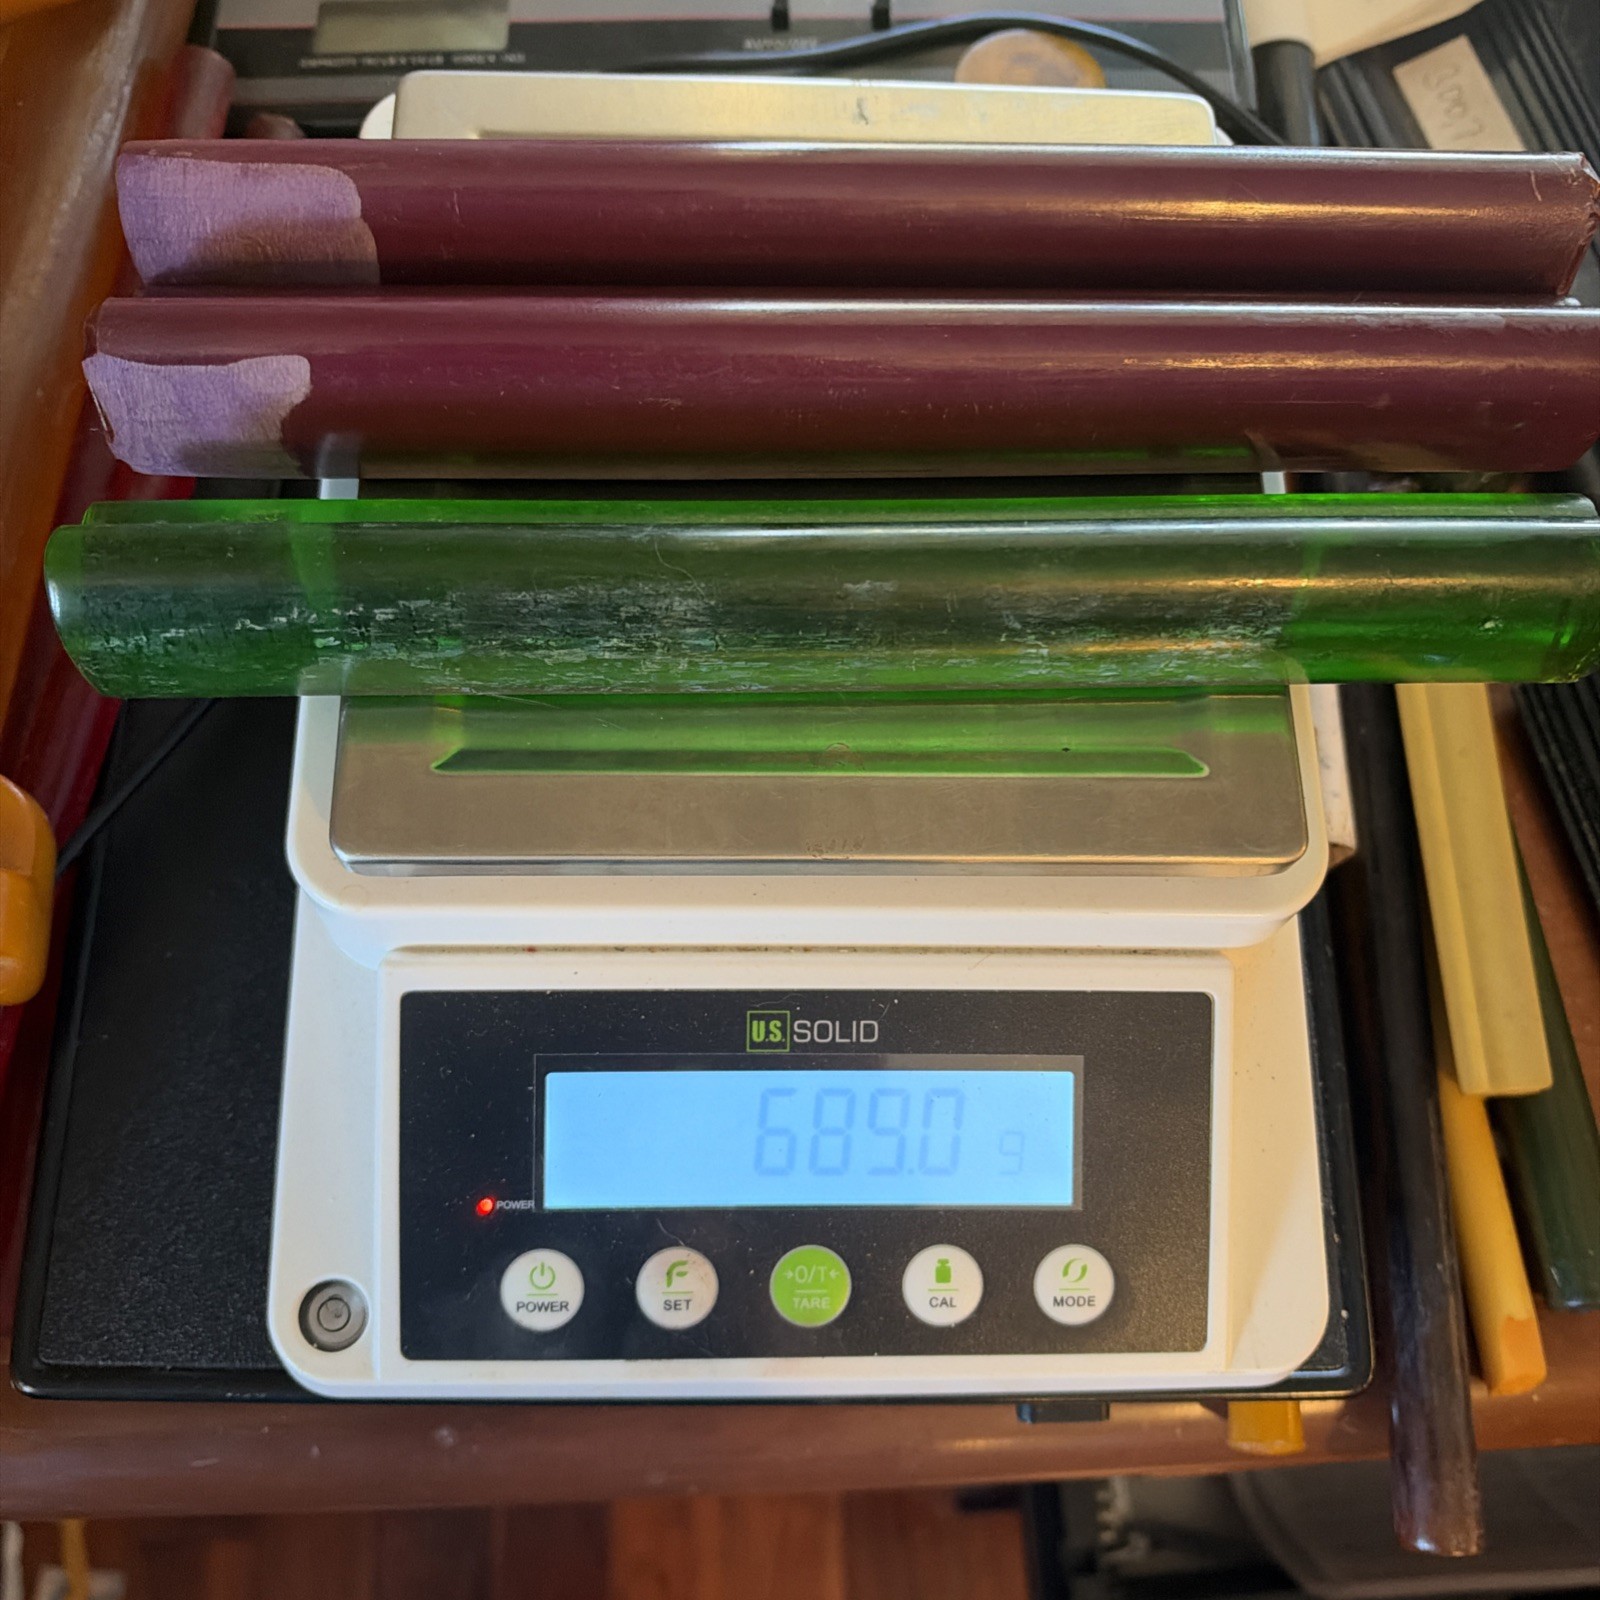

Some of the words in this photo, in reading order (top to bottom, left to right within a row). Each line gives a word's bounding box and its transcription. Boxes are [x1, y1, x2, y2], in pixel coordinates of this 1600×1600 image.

[793, 1019, 879, 1043] SOLID
[753, 1087, 967, 1177] 689.0
[496, 1199, 535, 1211] POWER
[516, 1300, 569, 1313] POWER
[663, 1299, 691, 1312] SET
[792, 1296, 830, 1309] TARE
[929, 1296, 957, 1308] CAL
[1053, 1295, 1096, 1307] MODE
